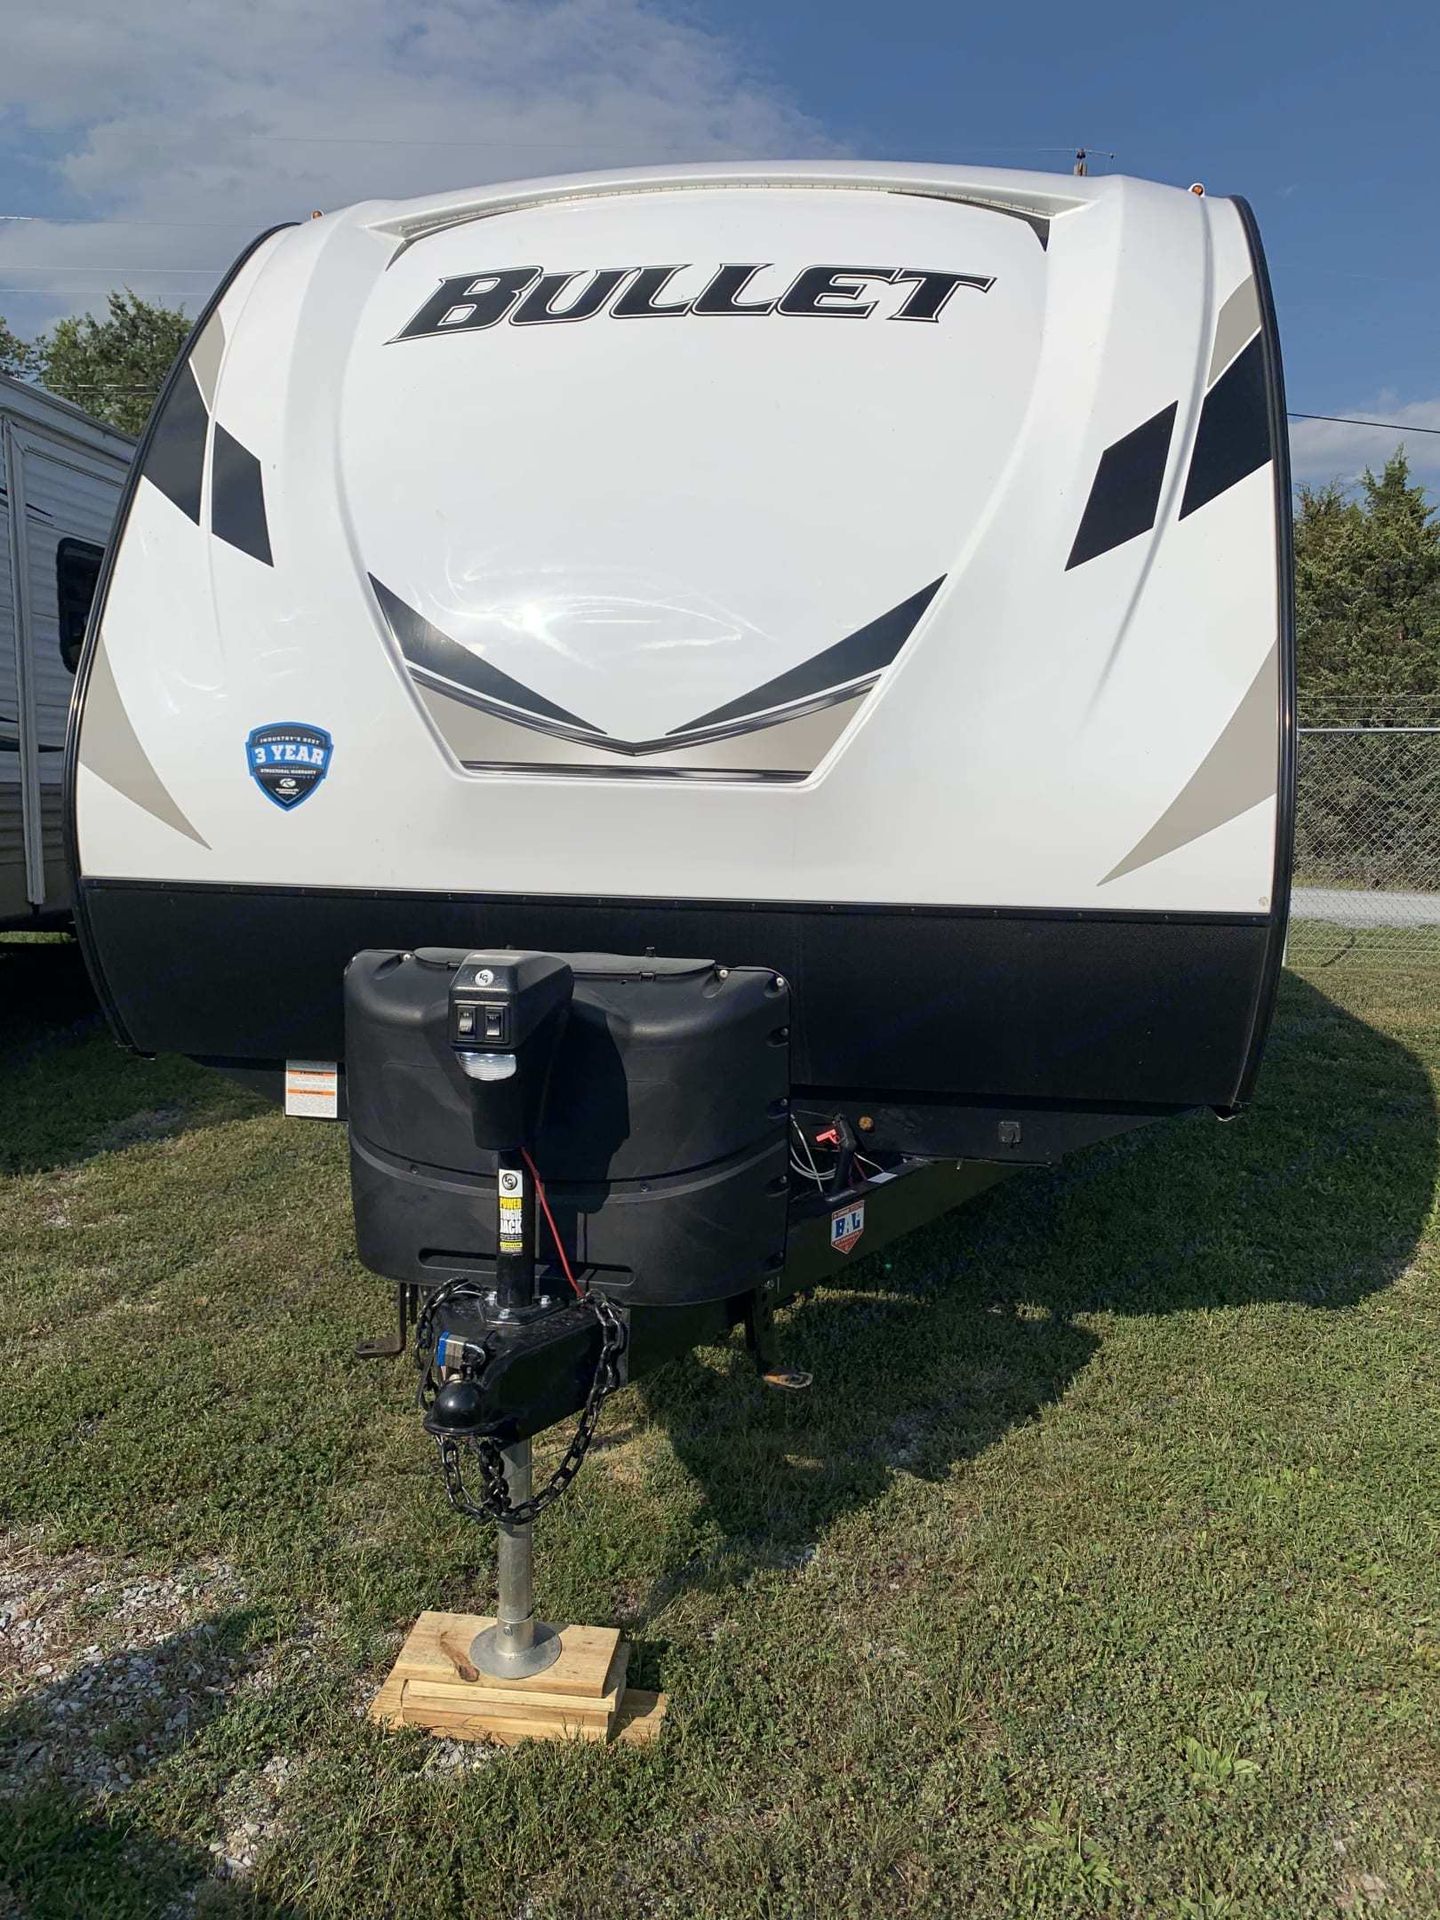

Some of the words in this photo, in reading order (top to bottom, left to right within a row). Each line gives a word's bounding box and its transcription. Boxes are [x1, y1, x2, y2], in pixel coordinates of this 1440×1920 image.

[384, 263, 996, 345] BULLET
[254, 747, 266, 763] 3
[271, 744, 324, 765] YEAR
[500, 1219, 523, 1234] JACK
